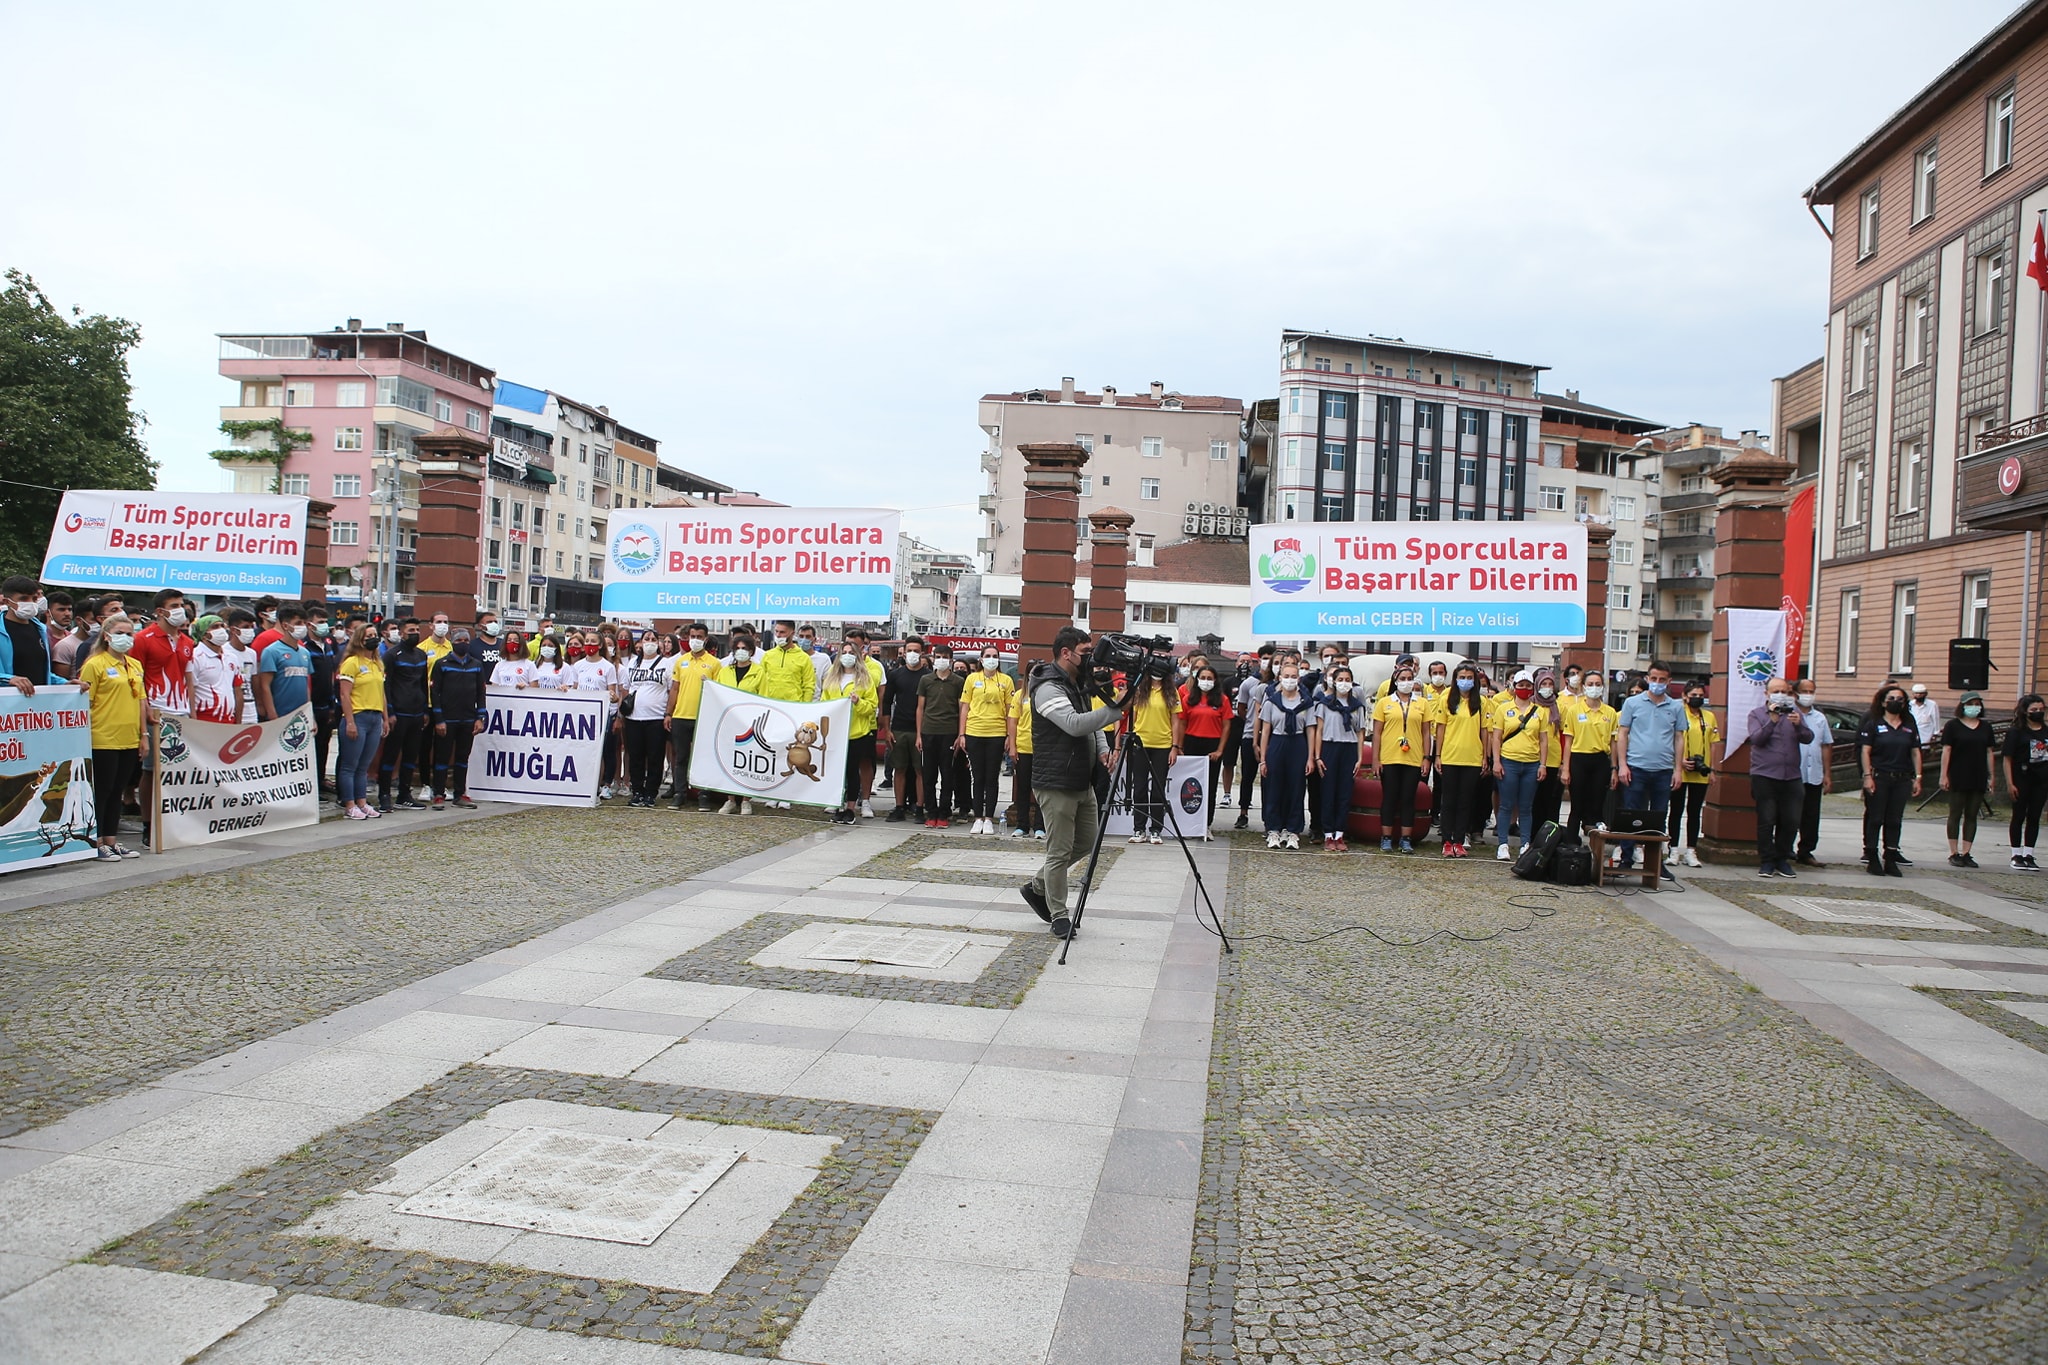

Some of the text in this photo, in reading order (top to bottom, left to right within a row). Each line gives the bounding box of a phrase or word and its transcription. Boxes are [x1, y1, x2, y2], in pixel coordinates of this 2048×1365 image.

[124, 503, 291, 530] Tüm Sporculara
[109, 528, 298, 556] Başarılar Dilerim
[678, 522, 883, 549] Tüm Sporculara
[668, 550, 891, 576] Başarılar Dilerim
[1334, 536, 1568, 565] Tüm Sporculara
[61, 562, 287, 586] Fikret YARDIMCI Federasyon Başkanı
[1325, 566, 1578, 594] Başarılar Dilerim
[656, 591, 840, 610] Ekrem ÇEÇEN Kaymakam
[1317, 611, 1520, 629] Kemal ÇEBER Rize Valisi
[190, 767, 210, 785] İLİ
[213, 768, 243, 788] ÇATAK
[242, 753, 310, 781] BELEDİYESİ
[486, 746, 579, 782] MUĞLA
[161, 779, 313, 816] ENÇLİK ve SPOR KULÜBÜ
[208, 811, 268, 834] DERNEĞİ
